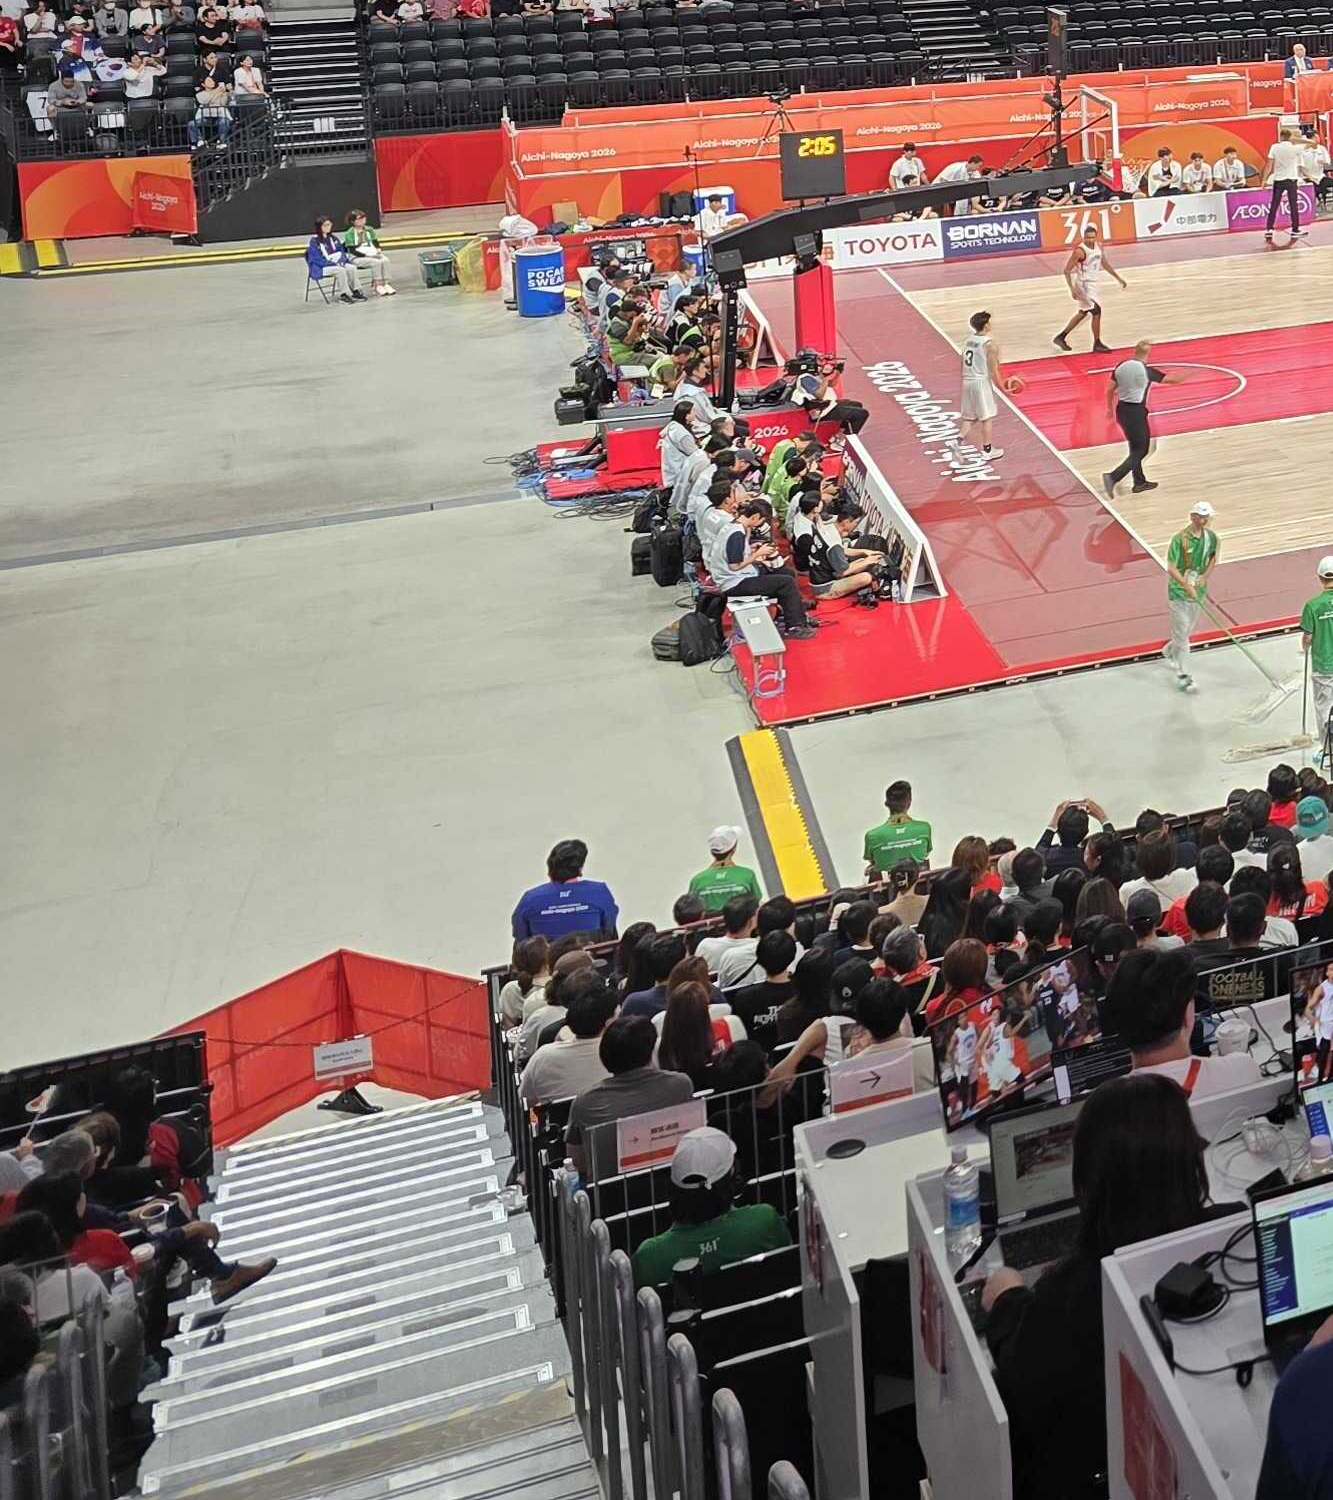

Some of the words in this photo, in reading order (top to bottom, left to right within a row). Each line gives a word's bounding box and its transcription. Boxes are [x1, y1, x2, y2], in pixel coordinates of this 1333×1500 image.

[1154, 101, 1209, 113] Aichi-Nagoya
[1210, 98, 1231, 108] 2026
[857, 123, 918, 137] Aichi-Nagoya
[919, 120, 943, 131] 2026
[693, 135, 758, 150] Aichi-Nagoya
[798, 135, 836, 157] 2:05
[520, 150, 589, 164] Aichi-Nagoya
[590, 148, 616, 159] 2026
[1176, 212, 1218, 226] 中部電力
[946, 219, 1037, 241] BORNAN
[844, 231, 938, 257] TOYOTA
[950, 237, 983, 250] SPORTS
[984, 233, 1038, 247] TECHNOLOGY
[965, 349, 974, 367] 3
[861, 360, 923, 393] 2026
[754, 425, 789, 440] 2026
[1210, 970, 1265, 985] FOOTBALL
